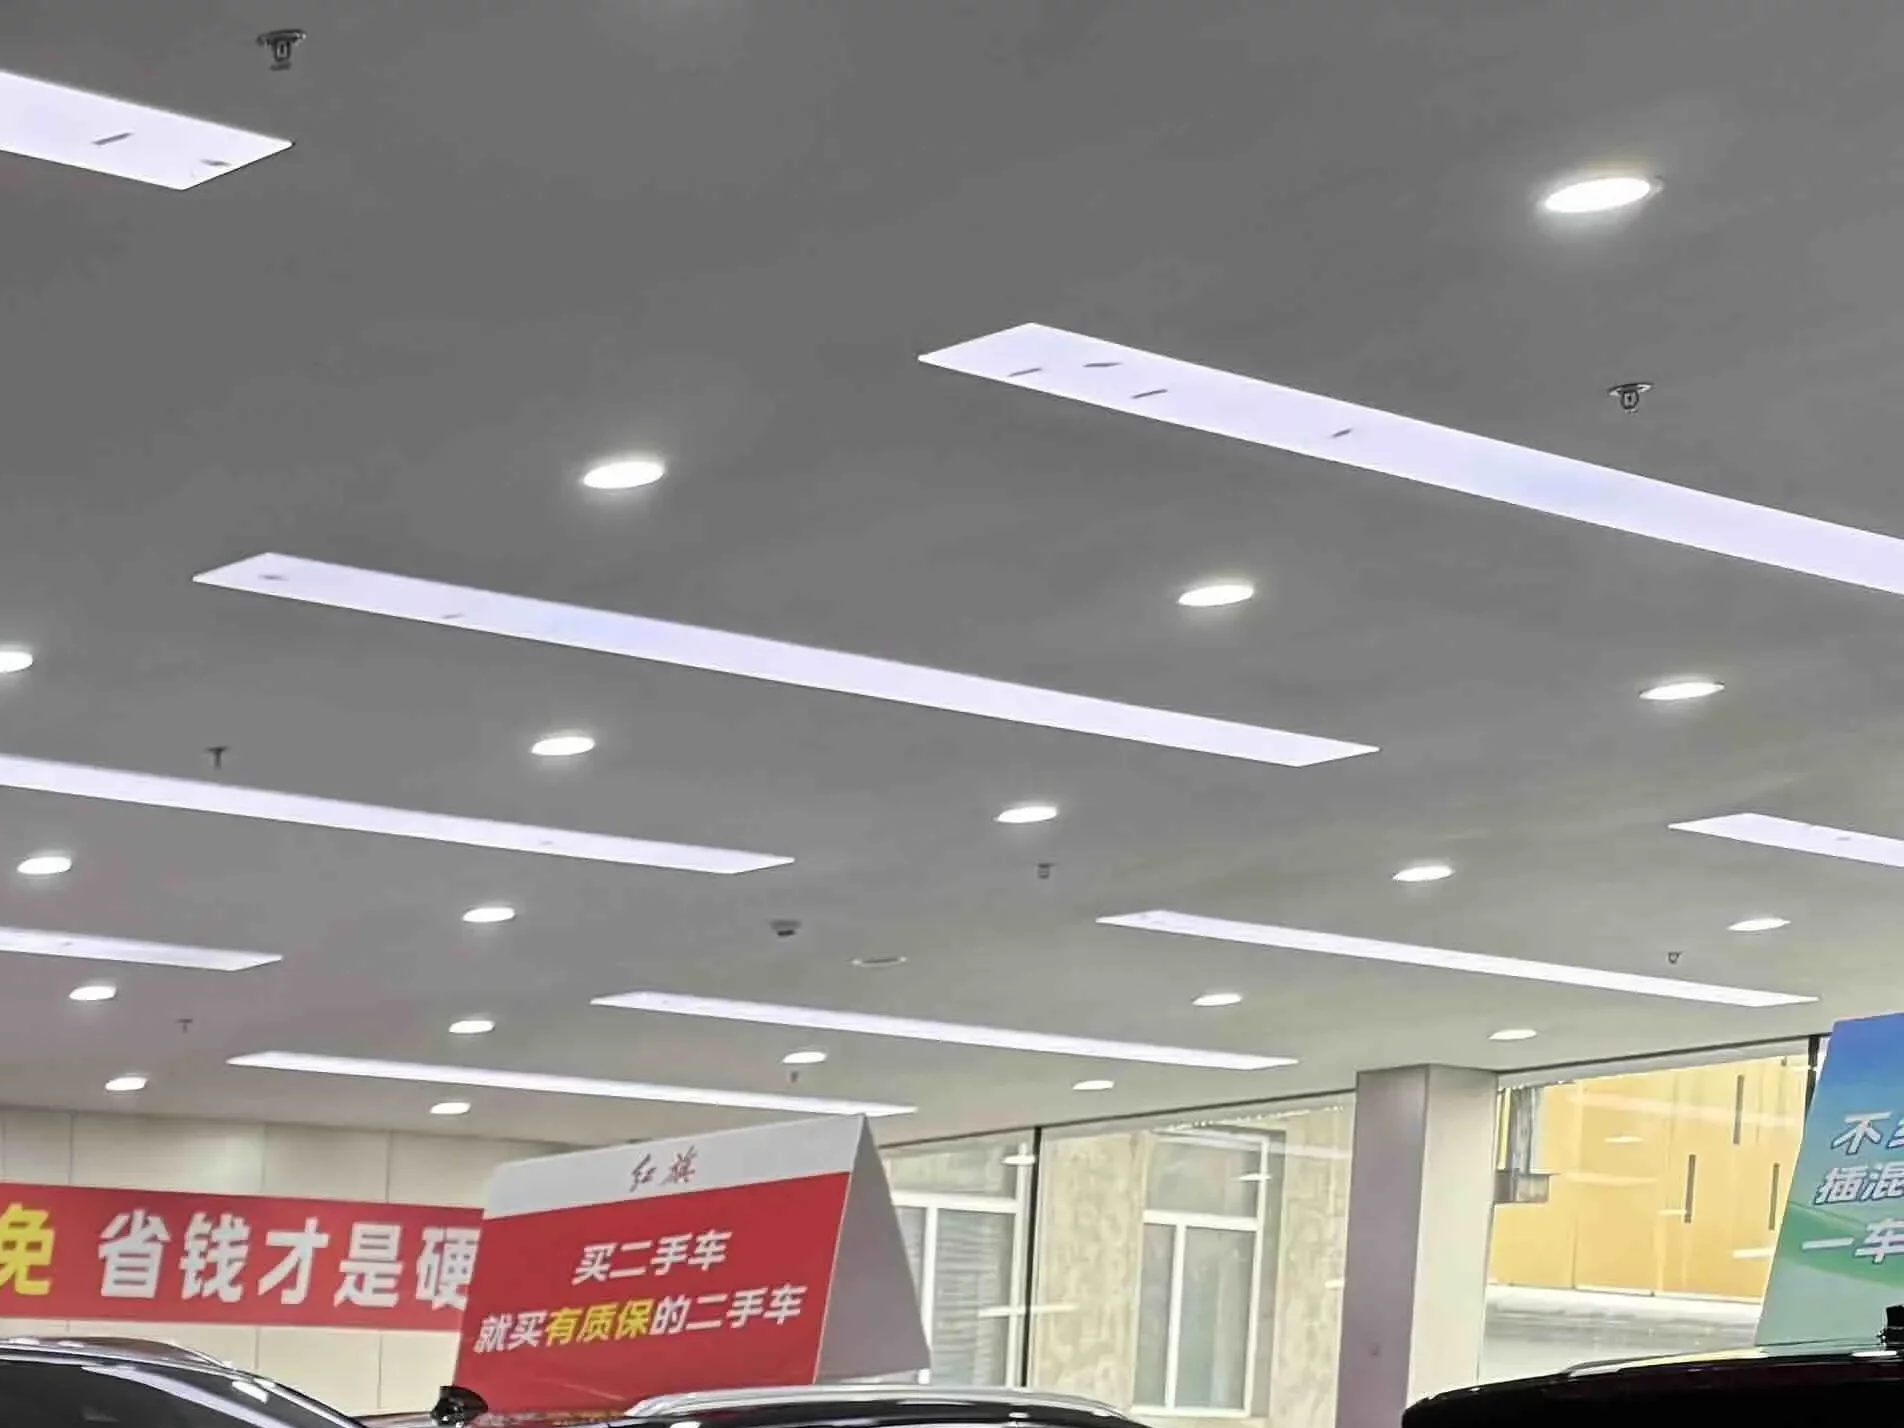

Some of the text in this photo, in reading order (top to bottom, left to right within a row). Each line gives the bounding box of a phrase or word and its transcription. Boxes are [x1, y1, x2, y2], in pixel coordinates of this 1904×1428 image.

[630, 1145, 700, 1193] 红旗
[572, 1228, 732, 1286] 买二手车
[474, 1283, 808, 1353] 就买有质保的二手车
